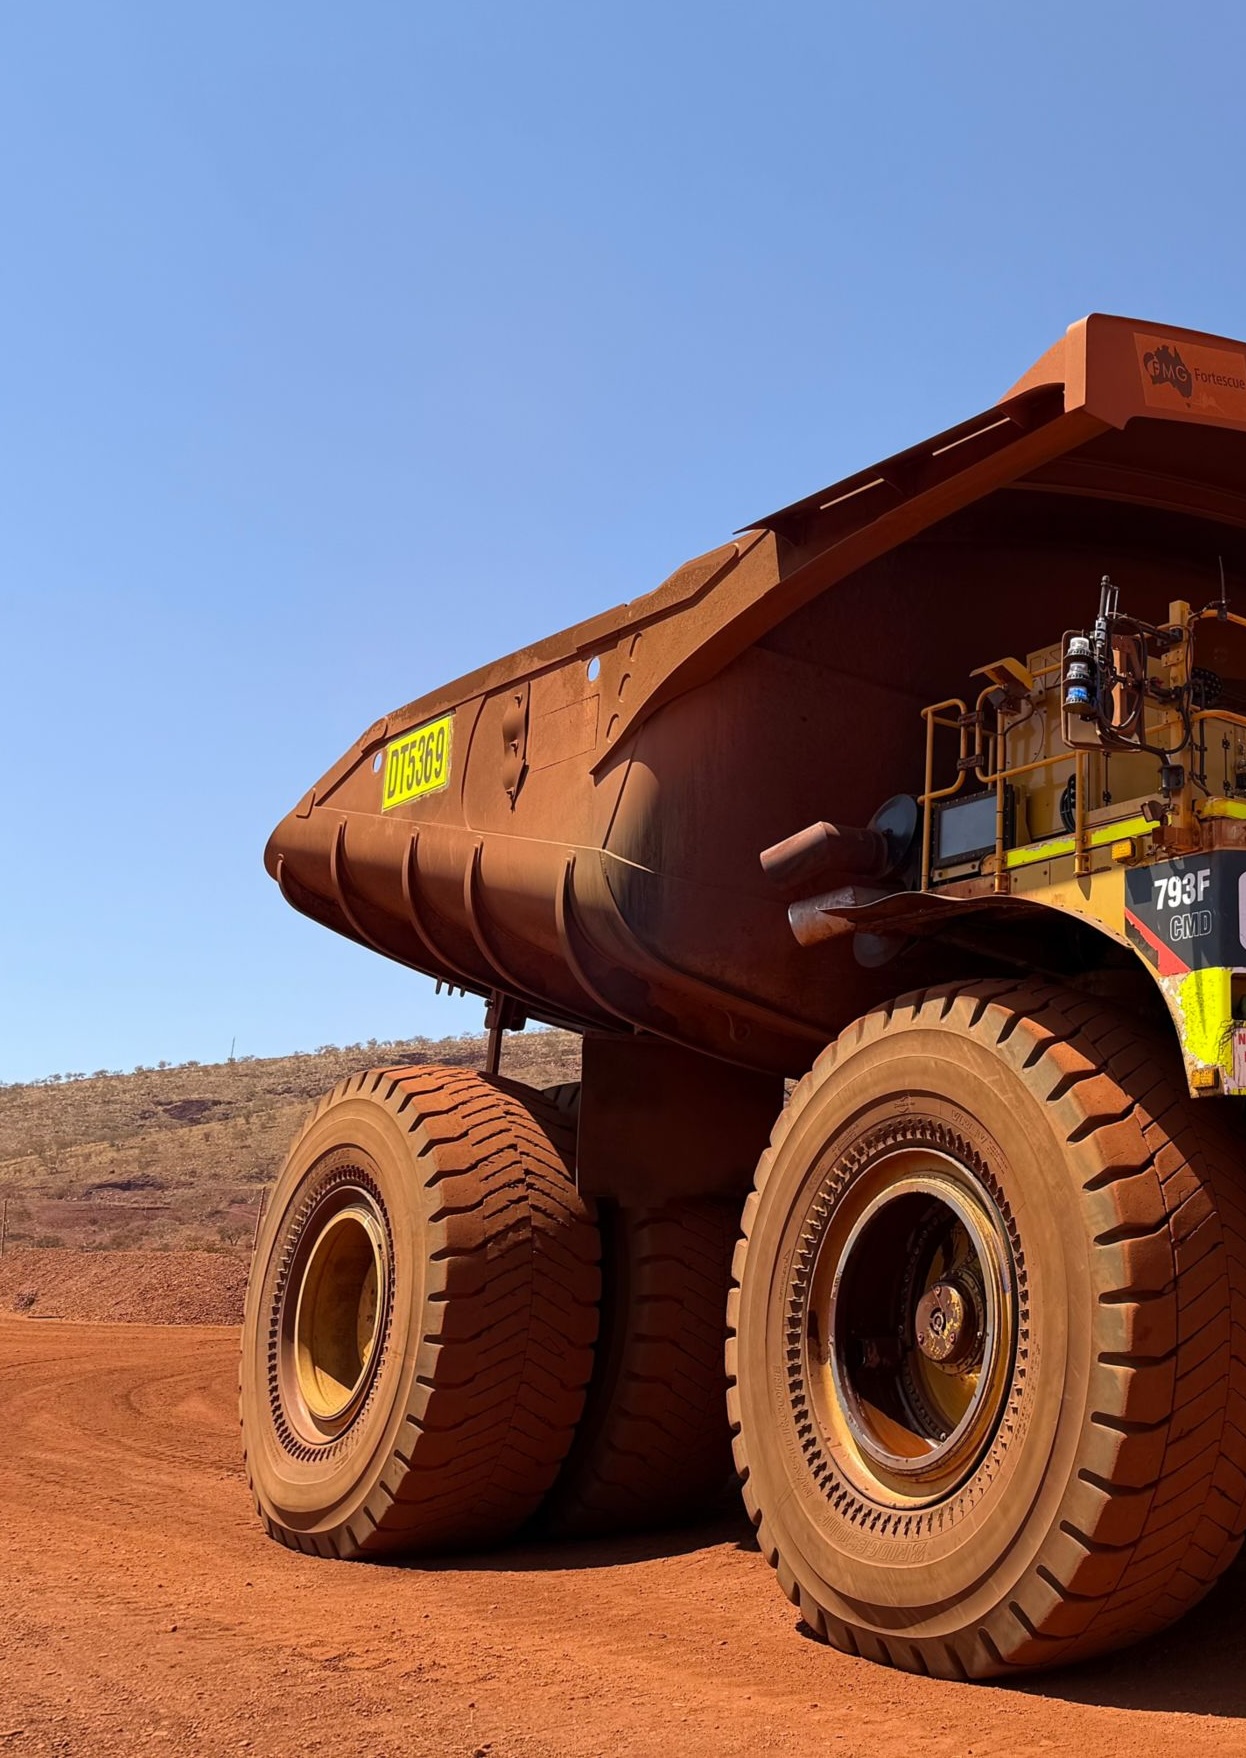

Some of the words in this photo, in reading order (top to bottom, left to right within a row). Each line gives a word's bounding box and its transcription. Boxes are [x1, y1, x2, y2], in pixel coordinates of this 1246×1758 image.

[1152, 360, 1188, 382] FMG
[1194, 367, 1246, 390] Fortescue
[387, 726, 445, 800] DT5369
[1154, 867, 1211, 911] 793F
[1169, 908, 1212, 942] CMD
